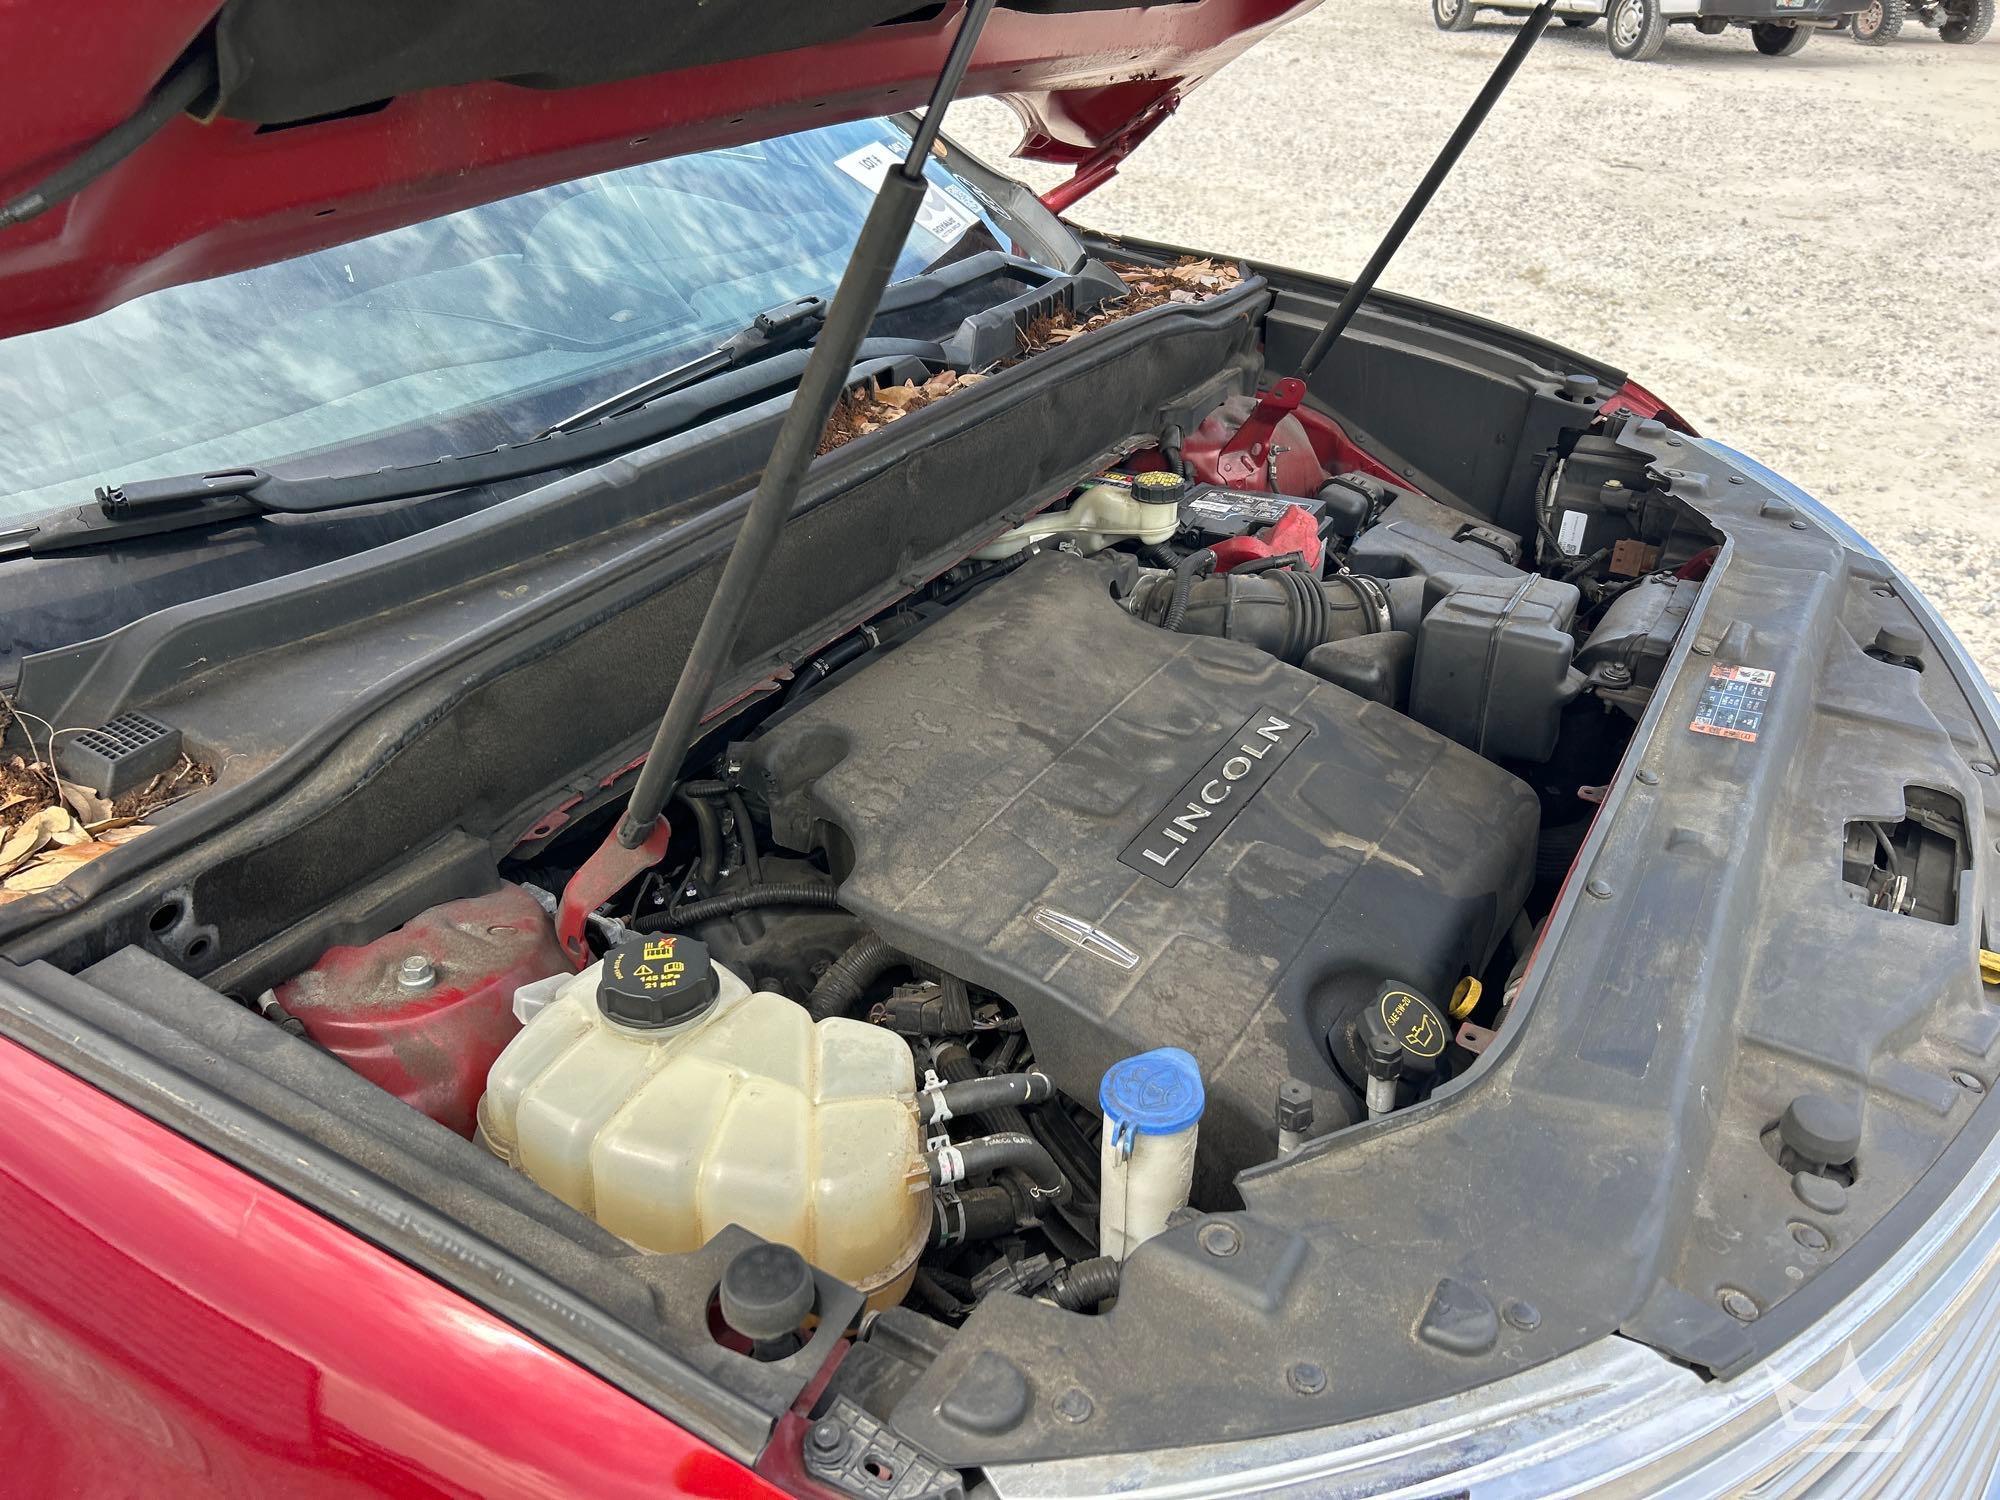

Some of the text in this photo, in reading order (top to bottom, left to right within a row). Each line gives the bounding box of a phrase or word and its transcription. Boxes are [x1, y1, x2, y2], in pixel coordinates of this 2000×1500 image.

[1142, 715, 1292, 866] LINCOLN
[660, 980, 676, 988] psi
[1388, 996, 1411, 1026] SAE 5W-20
